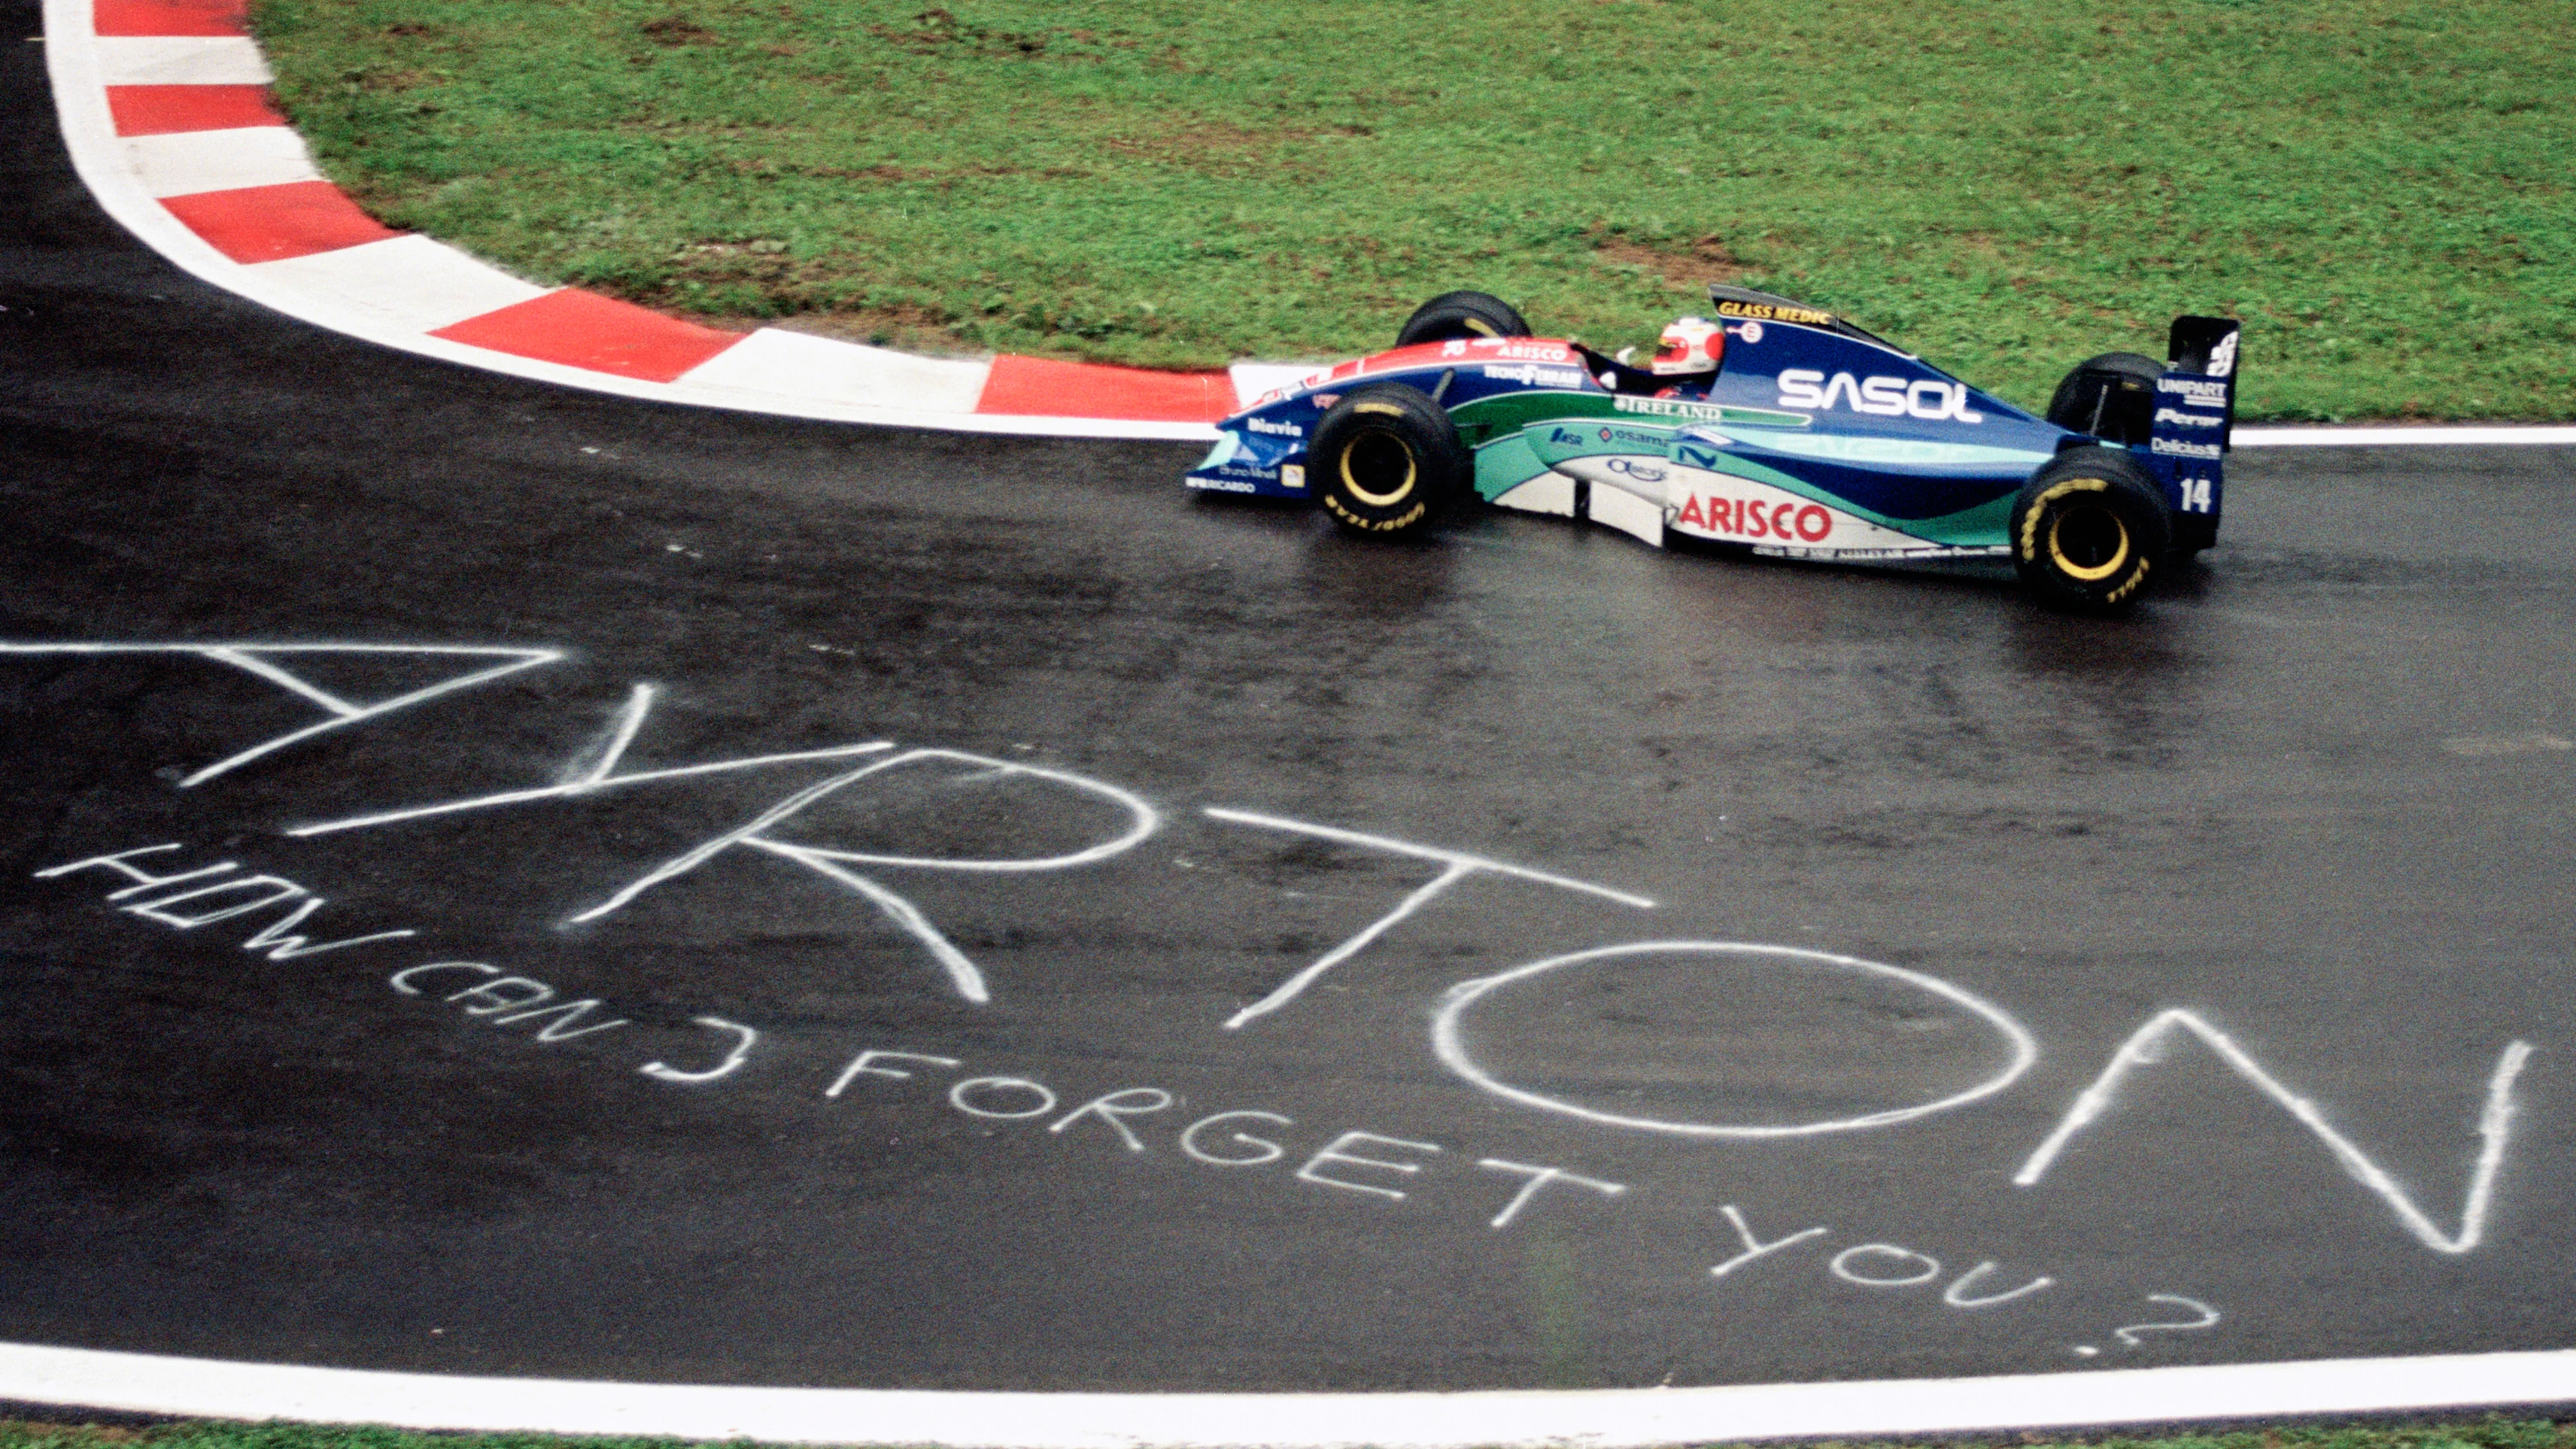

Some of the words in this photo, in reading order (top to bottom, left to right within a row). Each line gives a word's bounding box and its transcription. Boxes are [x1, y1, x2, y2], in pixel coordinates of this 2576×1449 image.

[1719, 301, 1773, 318] GLASS
[1774, 307, 1833, 325] MEDIC
[1497, 346, 1567, 361] ARISCO
[1777, 368, 1983, 423] SASOL
[2157, 378, 2227, 397] UNIPART
[1627, 397, 1722, 420] IRELAND
[2180, 477, 2211, 513] 14
[1678, 492, 1833, 542] ARISCO
[0, 639, 2536, 1254] AYRTON
[34, 841, 416, 960] HOW
[390, 961, 632, 1042] CAN
[825, 1050, 1627, 1226] FORGET
